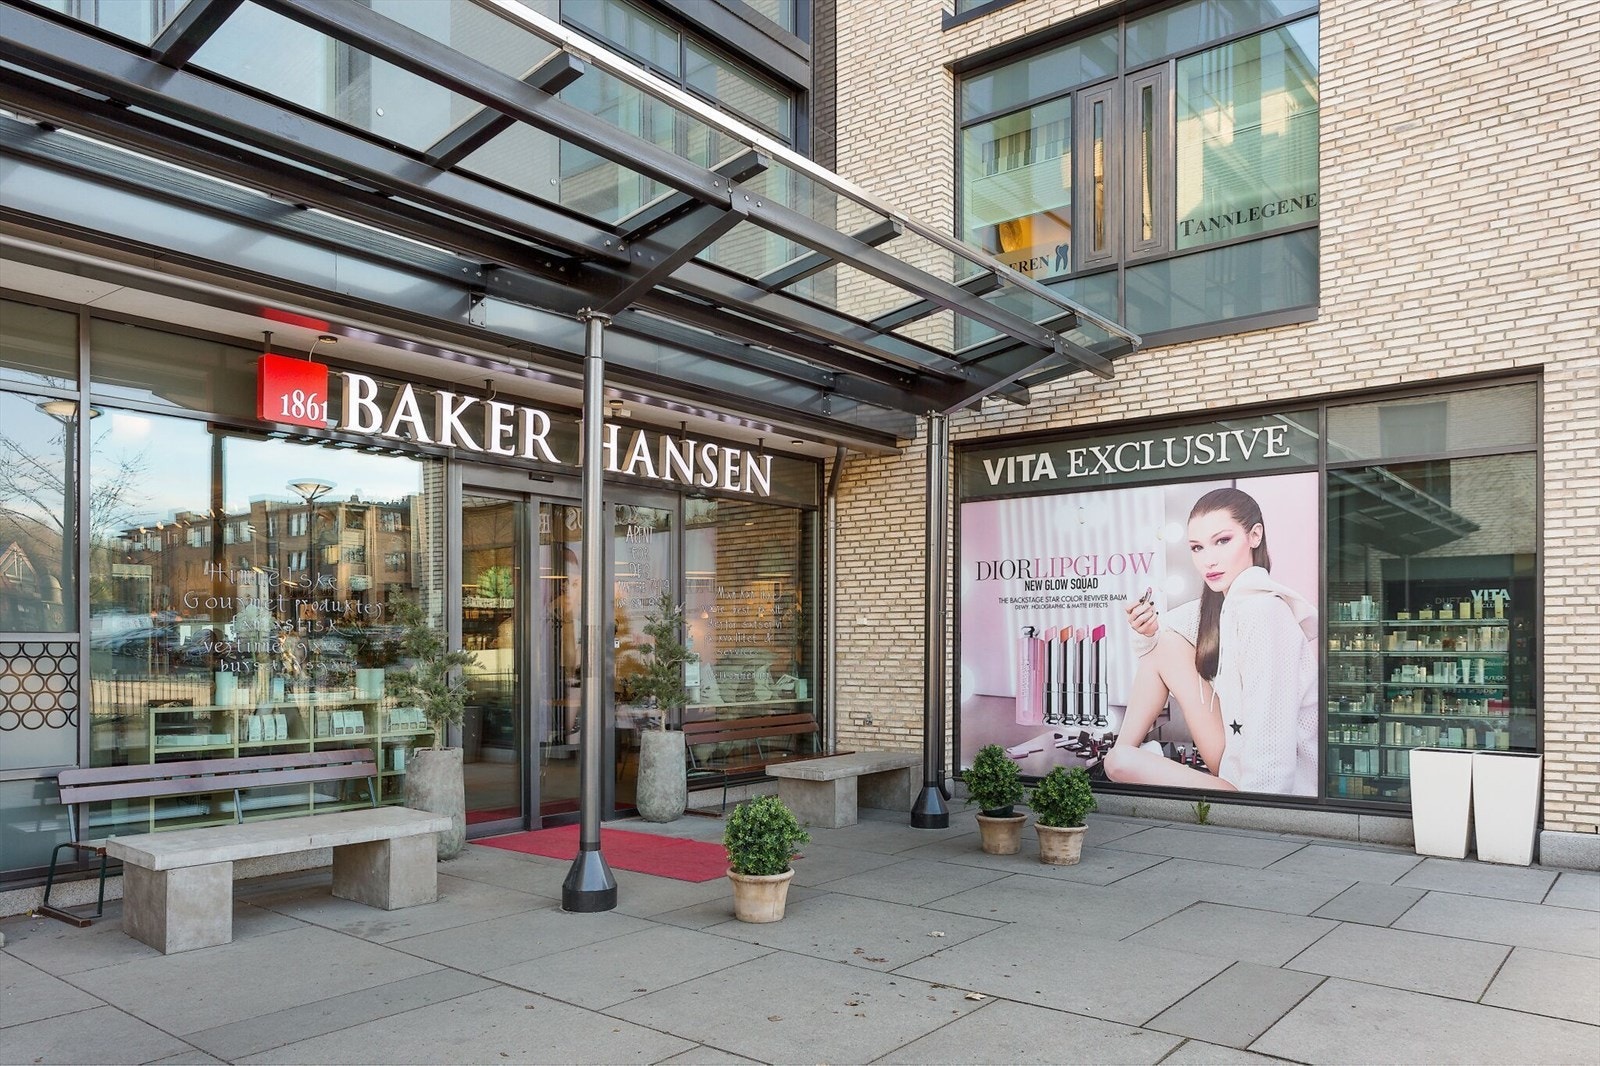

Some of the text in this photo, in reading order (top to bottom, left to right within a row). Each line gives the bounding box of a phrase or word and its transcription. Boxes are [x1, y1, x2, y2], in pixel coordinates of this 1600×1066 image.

[1179, 192, 1318, 237] TANNLEGENE
[280, 389, 328, 423] 1861
[340, 371, 774, 497] BAKER HANSEN
[982, 424, 1290, 486] VITA EXCLUSIVE
[1024, 577, 1099, 592] NEW GLOW SQUAD
[1470, 588, 1512, 601] VITA
[183, 590, 288, 613] Gourmet
[1010, 596, 1044, 604] BACKSTAGE
[1084, 594, 1109, 602] REVIVER
